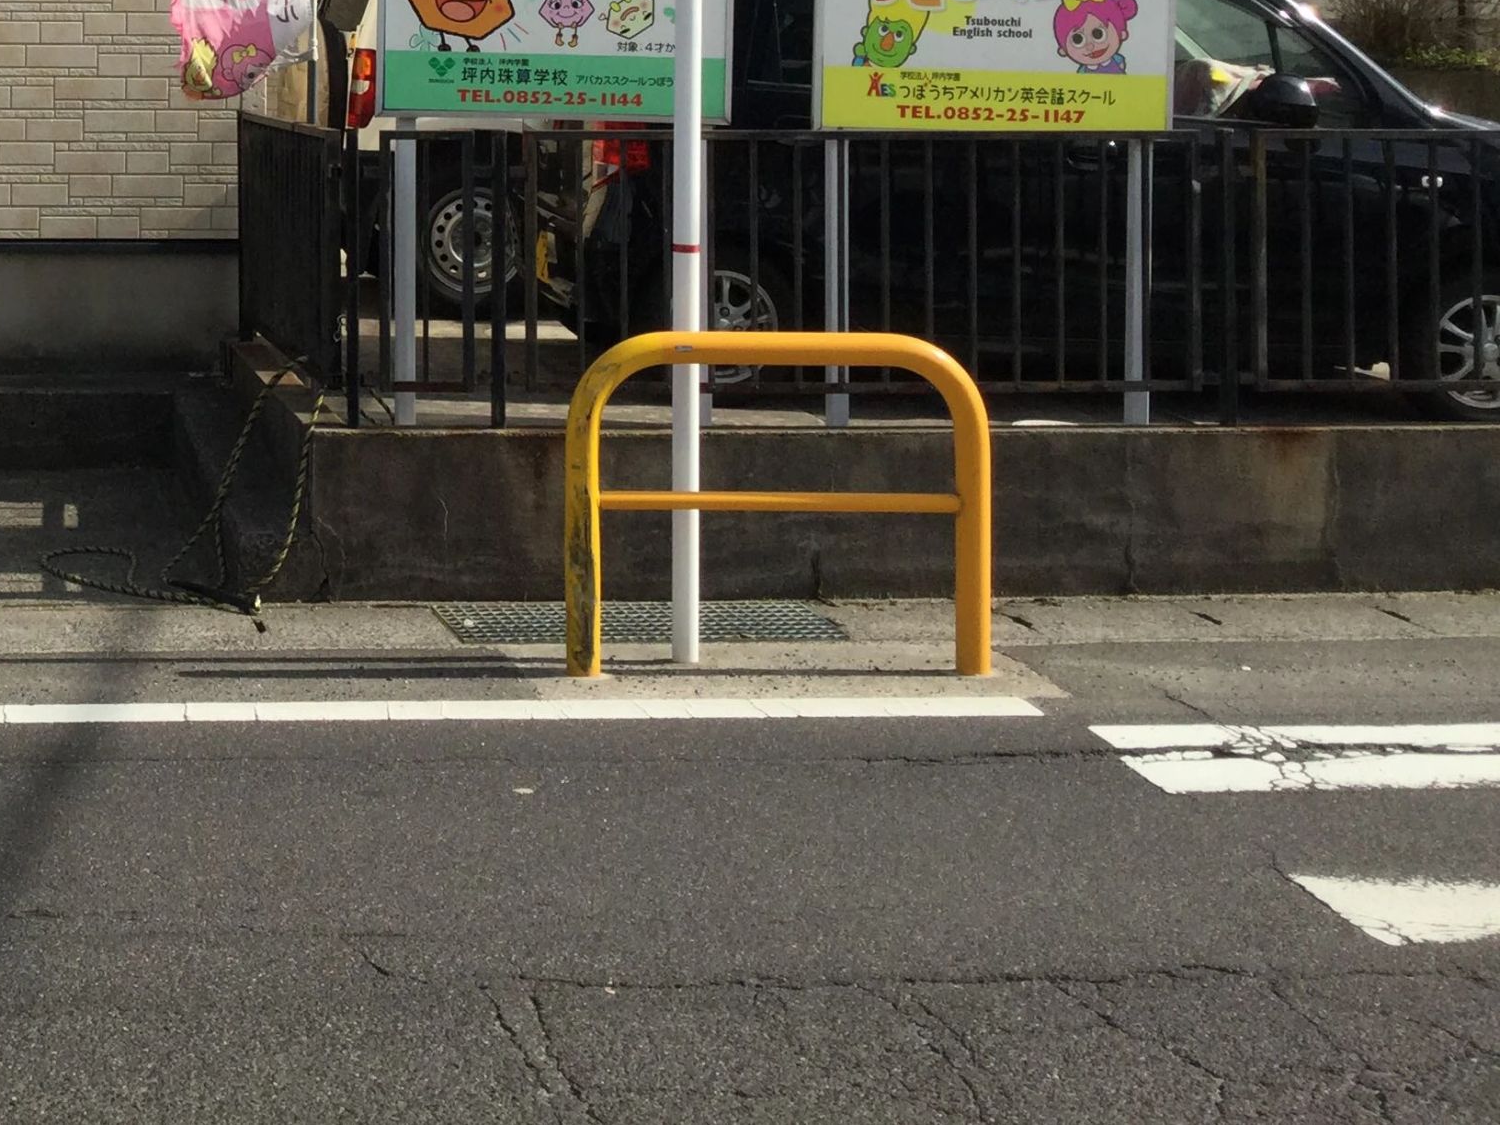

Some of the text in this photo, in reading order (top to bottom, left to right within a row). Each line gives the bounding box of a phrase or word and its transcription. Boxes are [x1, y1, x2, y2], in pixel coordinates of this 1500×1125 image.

[964, 15, 1022, 27] Tsubouchi
[952, 26, 1033, 39] English school
[461, 66, 568, 86] 坪内珠算学校
[457, 89, 643, 107] TEL.0852-25-1144
[899, 82, 1116, 105] つぼうちアメリカン英会話スクール
[897, 105, 1085, 124] TEL.0852-25-1147
